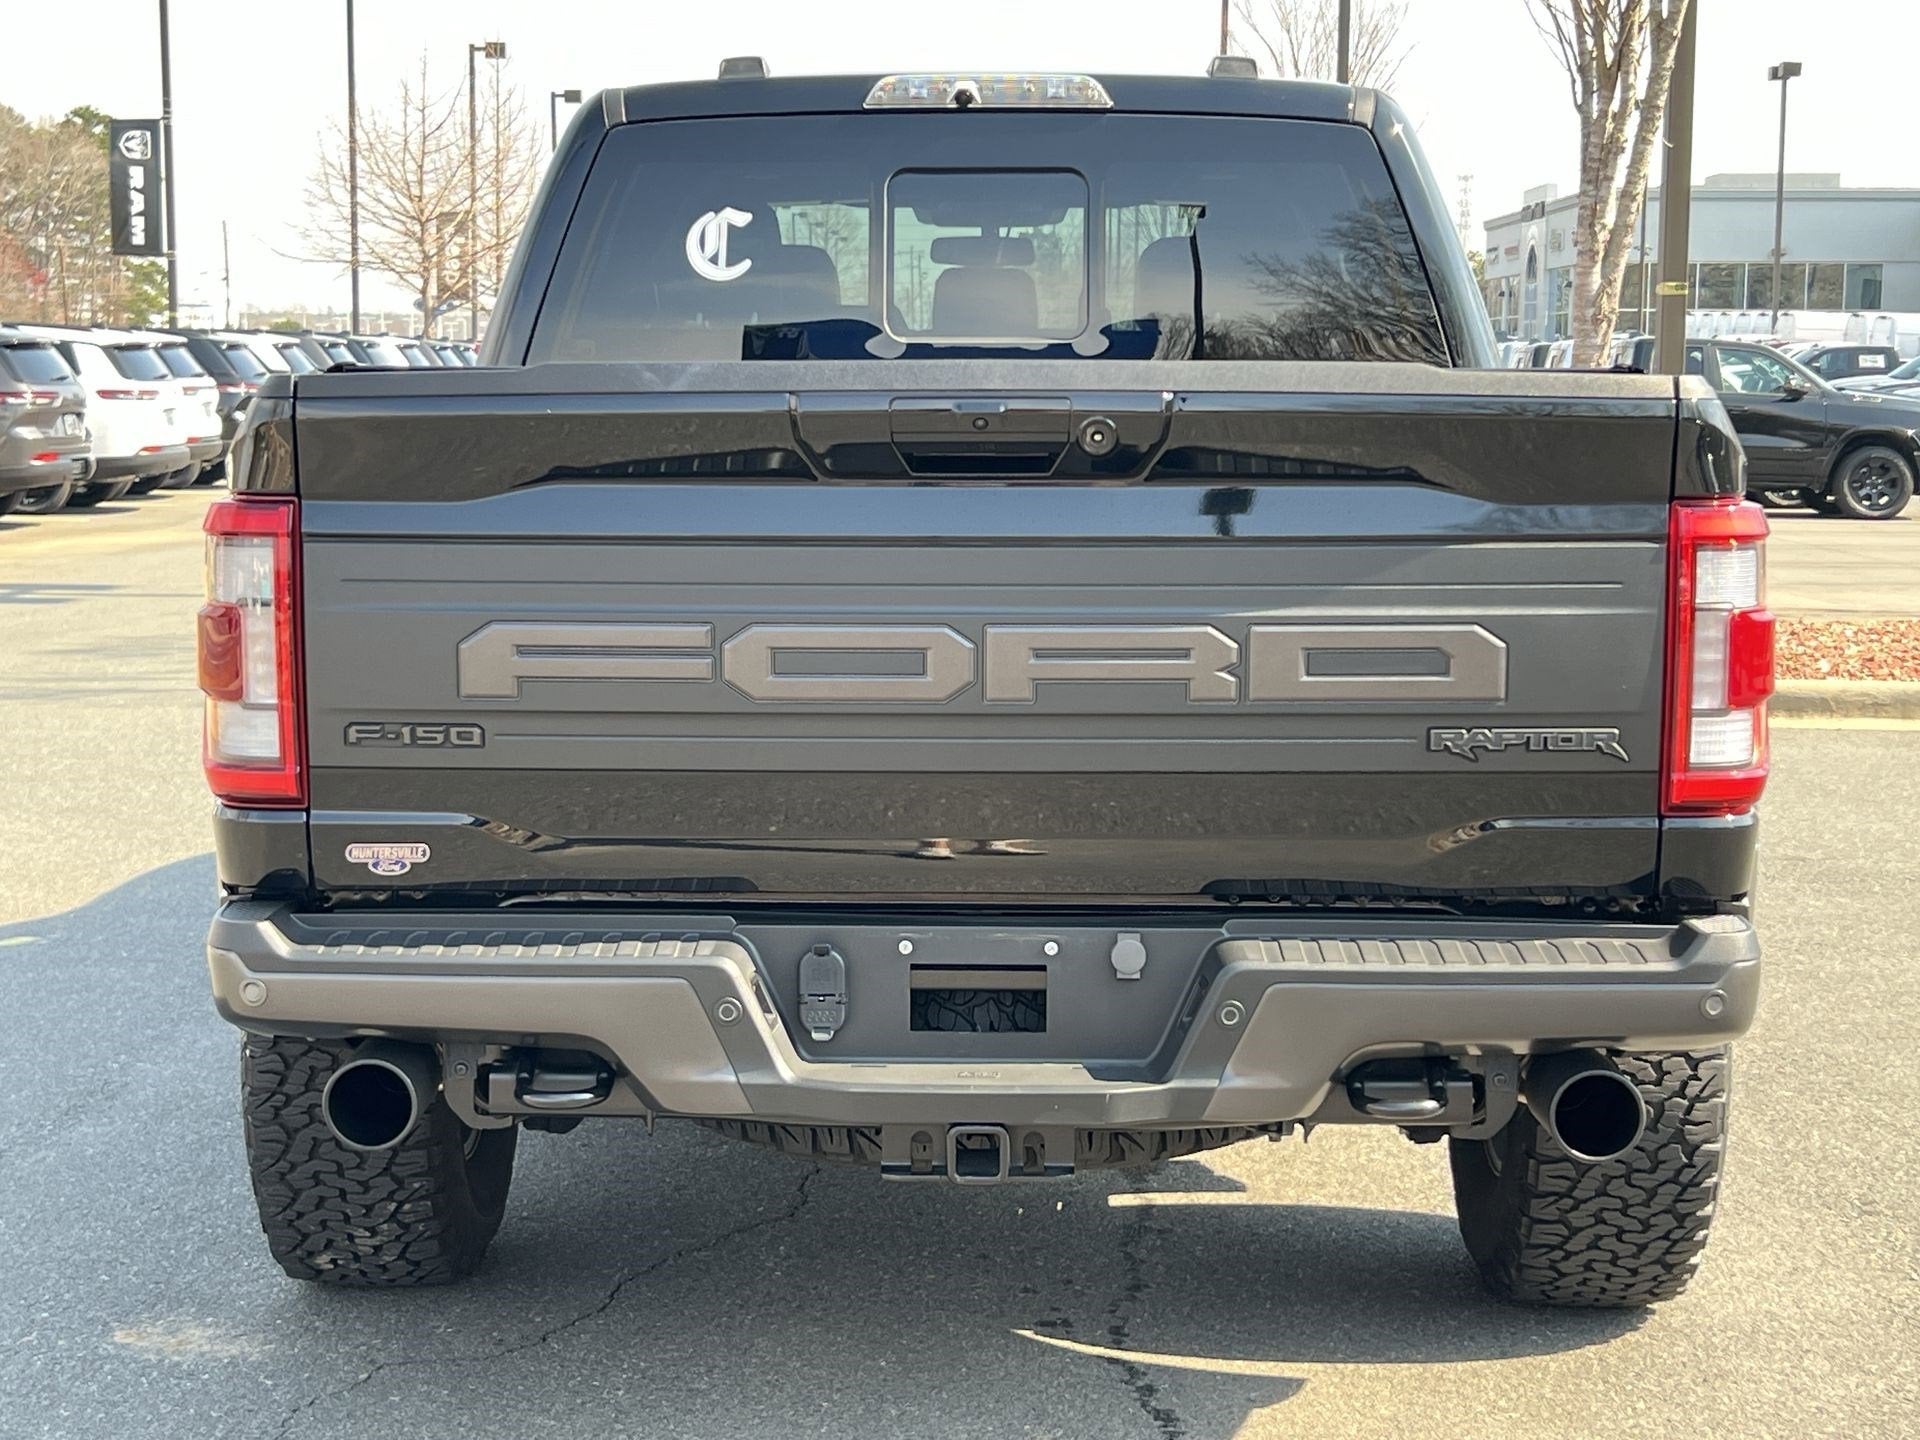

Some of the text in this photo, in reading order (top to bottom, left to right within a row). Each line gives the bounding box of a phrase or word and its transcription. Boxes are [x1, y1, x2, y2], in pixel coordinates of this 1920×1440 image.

[128, 165, 146, 246] RAM
[685, 206, 753, 282] C
[458, 622, 1508, 704] FORD
[346, 723, 484, 747] F-150
[1429, 727, 1630, 763] RAPTOR
[350, 847, 426, 859] HUNTERSVILLE
